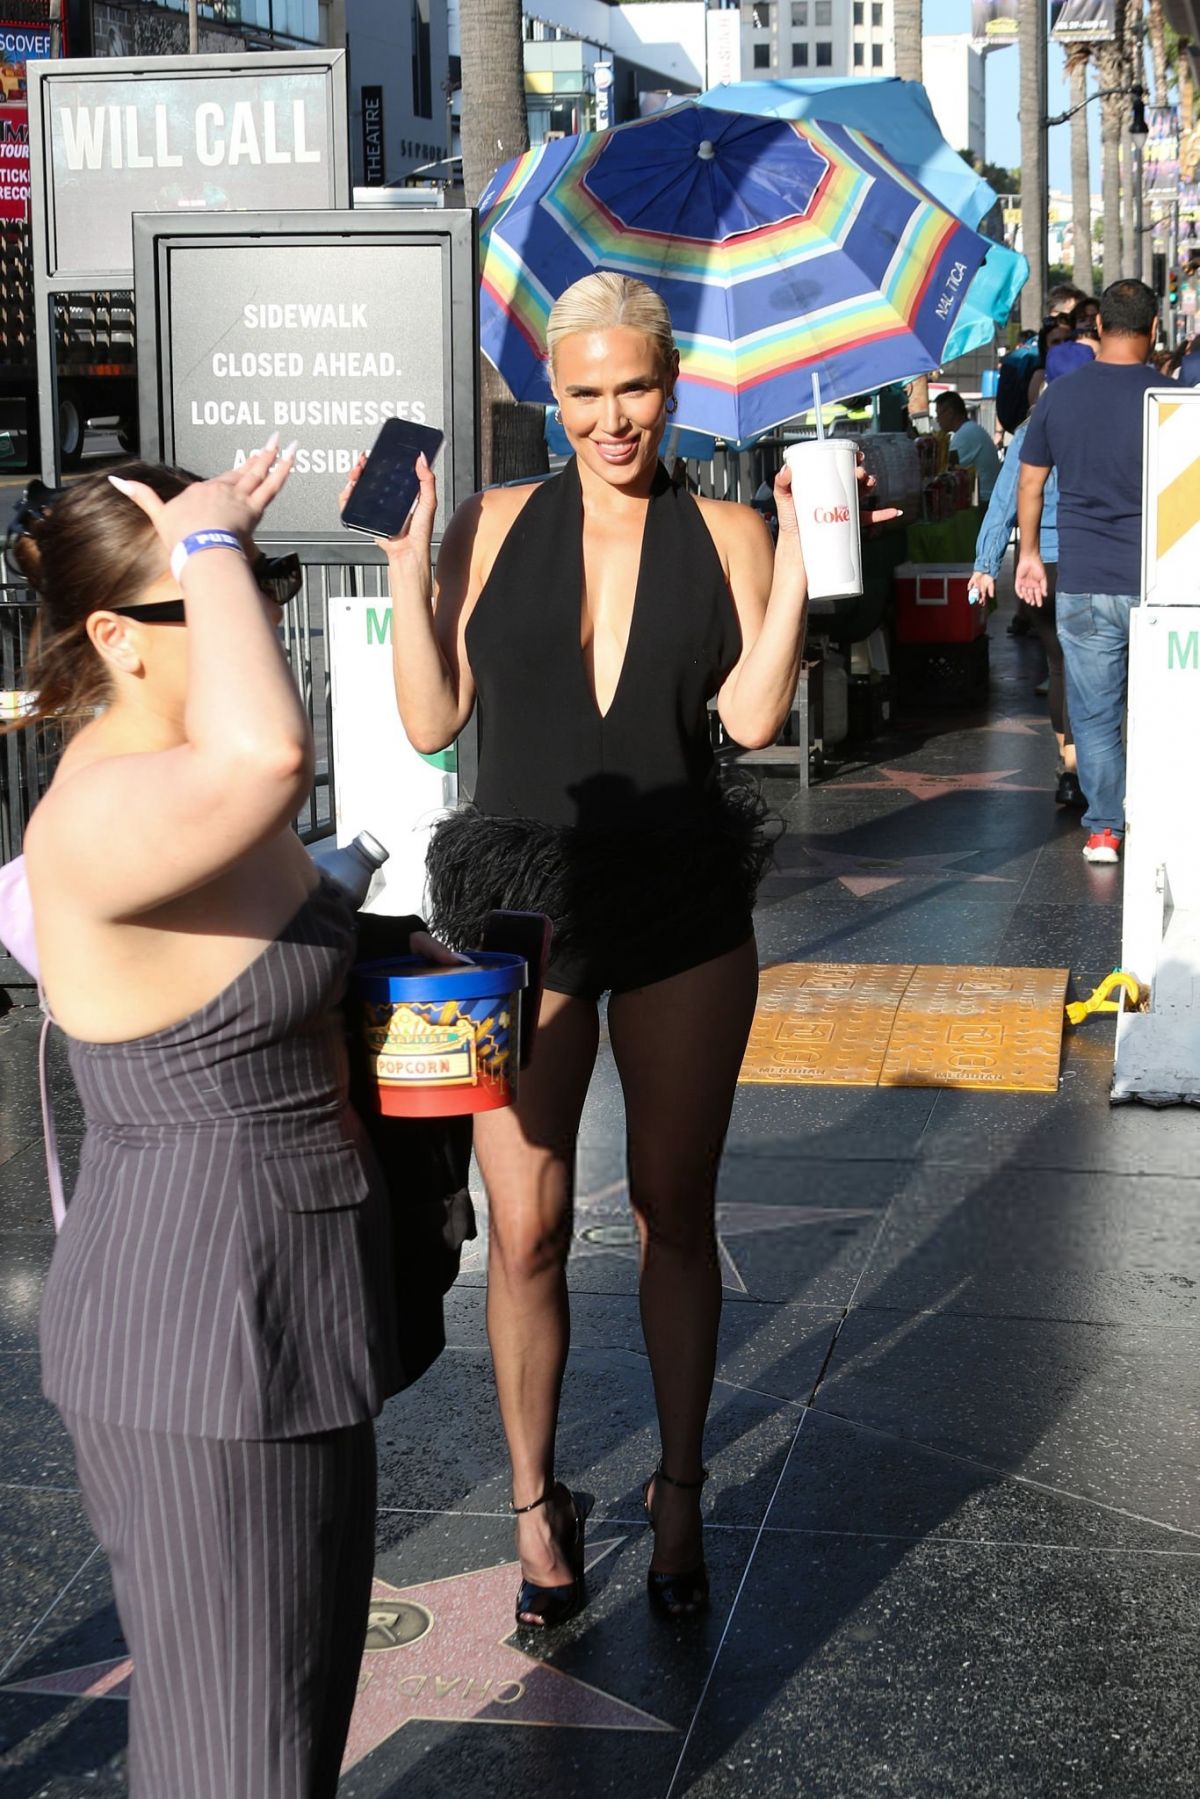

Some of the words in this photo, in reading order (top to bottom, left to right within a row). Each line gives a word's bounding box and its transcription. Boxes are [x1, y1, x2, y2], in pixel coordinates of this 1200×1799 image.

[60, 104, 183, 170] WILL
[195, 100, 321, 166] CALL
[364, 97, 382, 182] THEATRE
[0, 168, 30, 183] TICK
[243, 303, 368, 329] SIDEWALK
[212, 352, 304, 377] CLOSED
[312, 352, 402, 377] AHEAD.
[191, 400, 266, 425] LOCAL
[274, 400, 426, 425] BUSINESSES
[813, 506, 850, 524] Coke
[379, 1059, 450, 1074] POPCORN
[400, 1676, 526, 1704] CHAD
